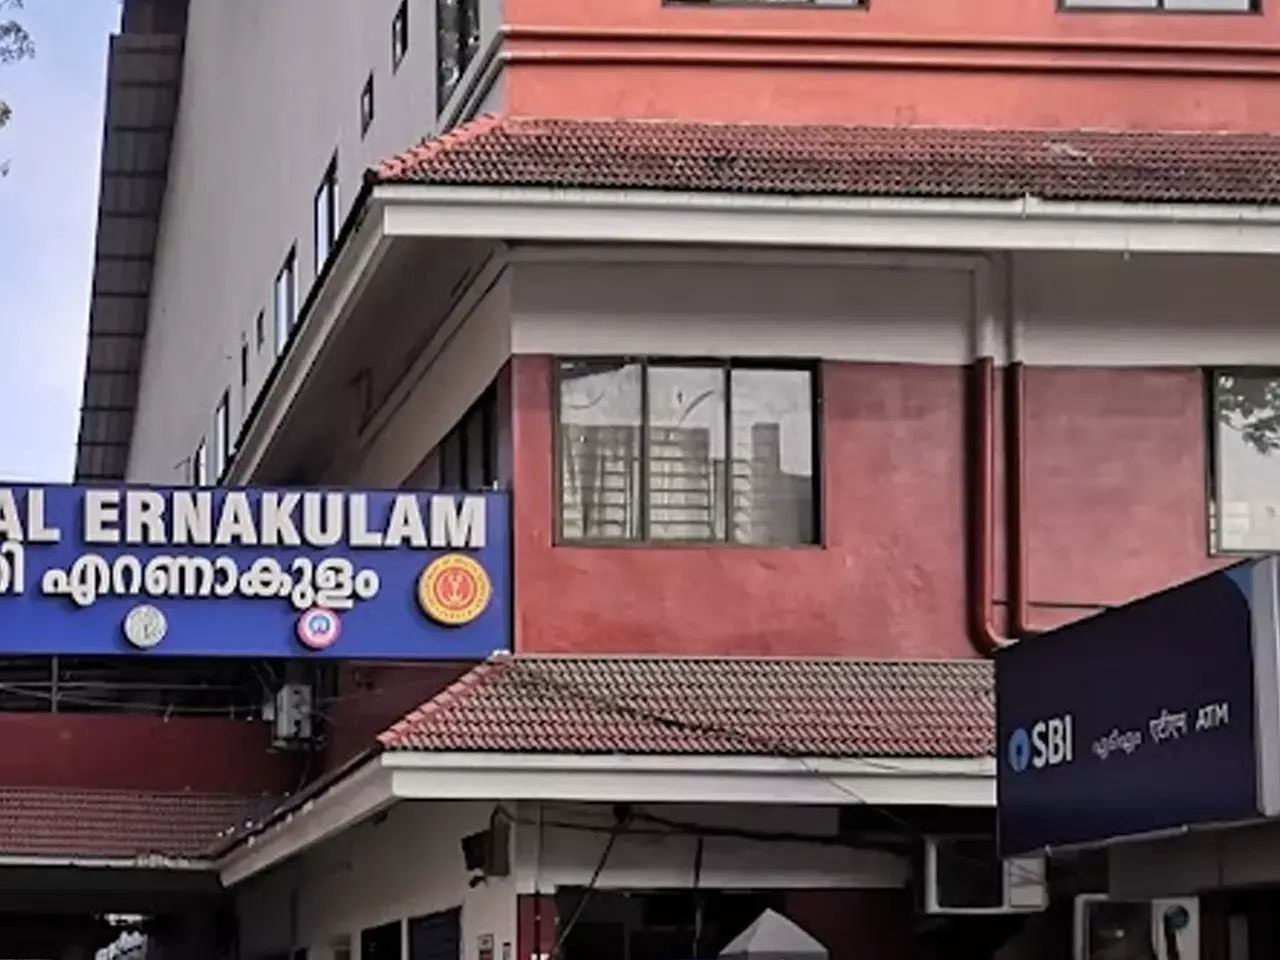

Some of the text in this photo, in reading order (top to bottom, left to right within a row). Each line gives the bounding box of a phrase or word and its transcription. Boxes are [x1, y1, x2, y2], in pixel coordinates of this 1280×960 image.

[84, 489, 488, 549] ERNAKULAM
[41, 550, 379, 610] എറണാകുളം
[1031, 713, 1073, 769] SBI
[1195, 702, 1229, 732] ATM
